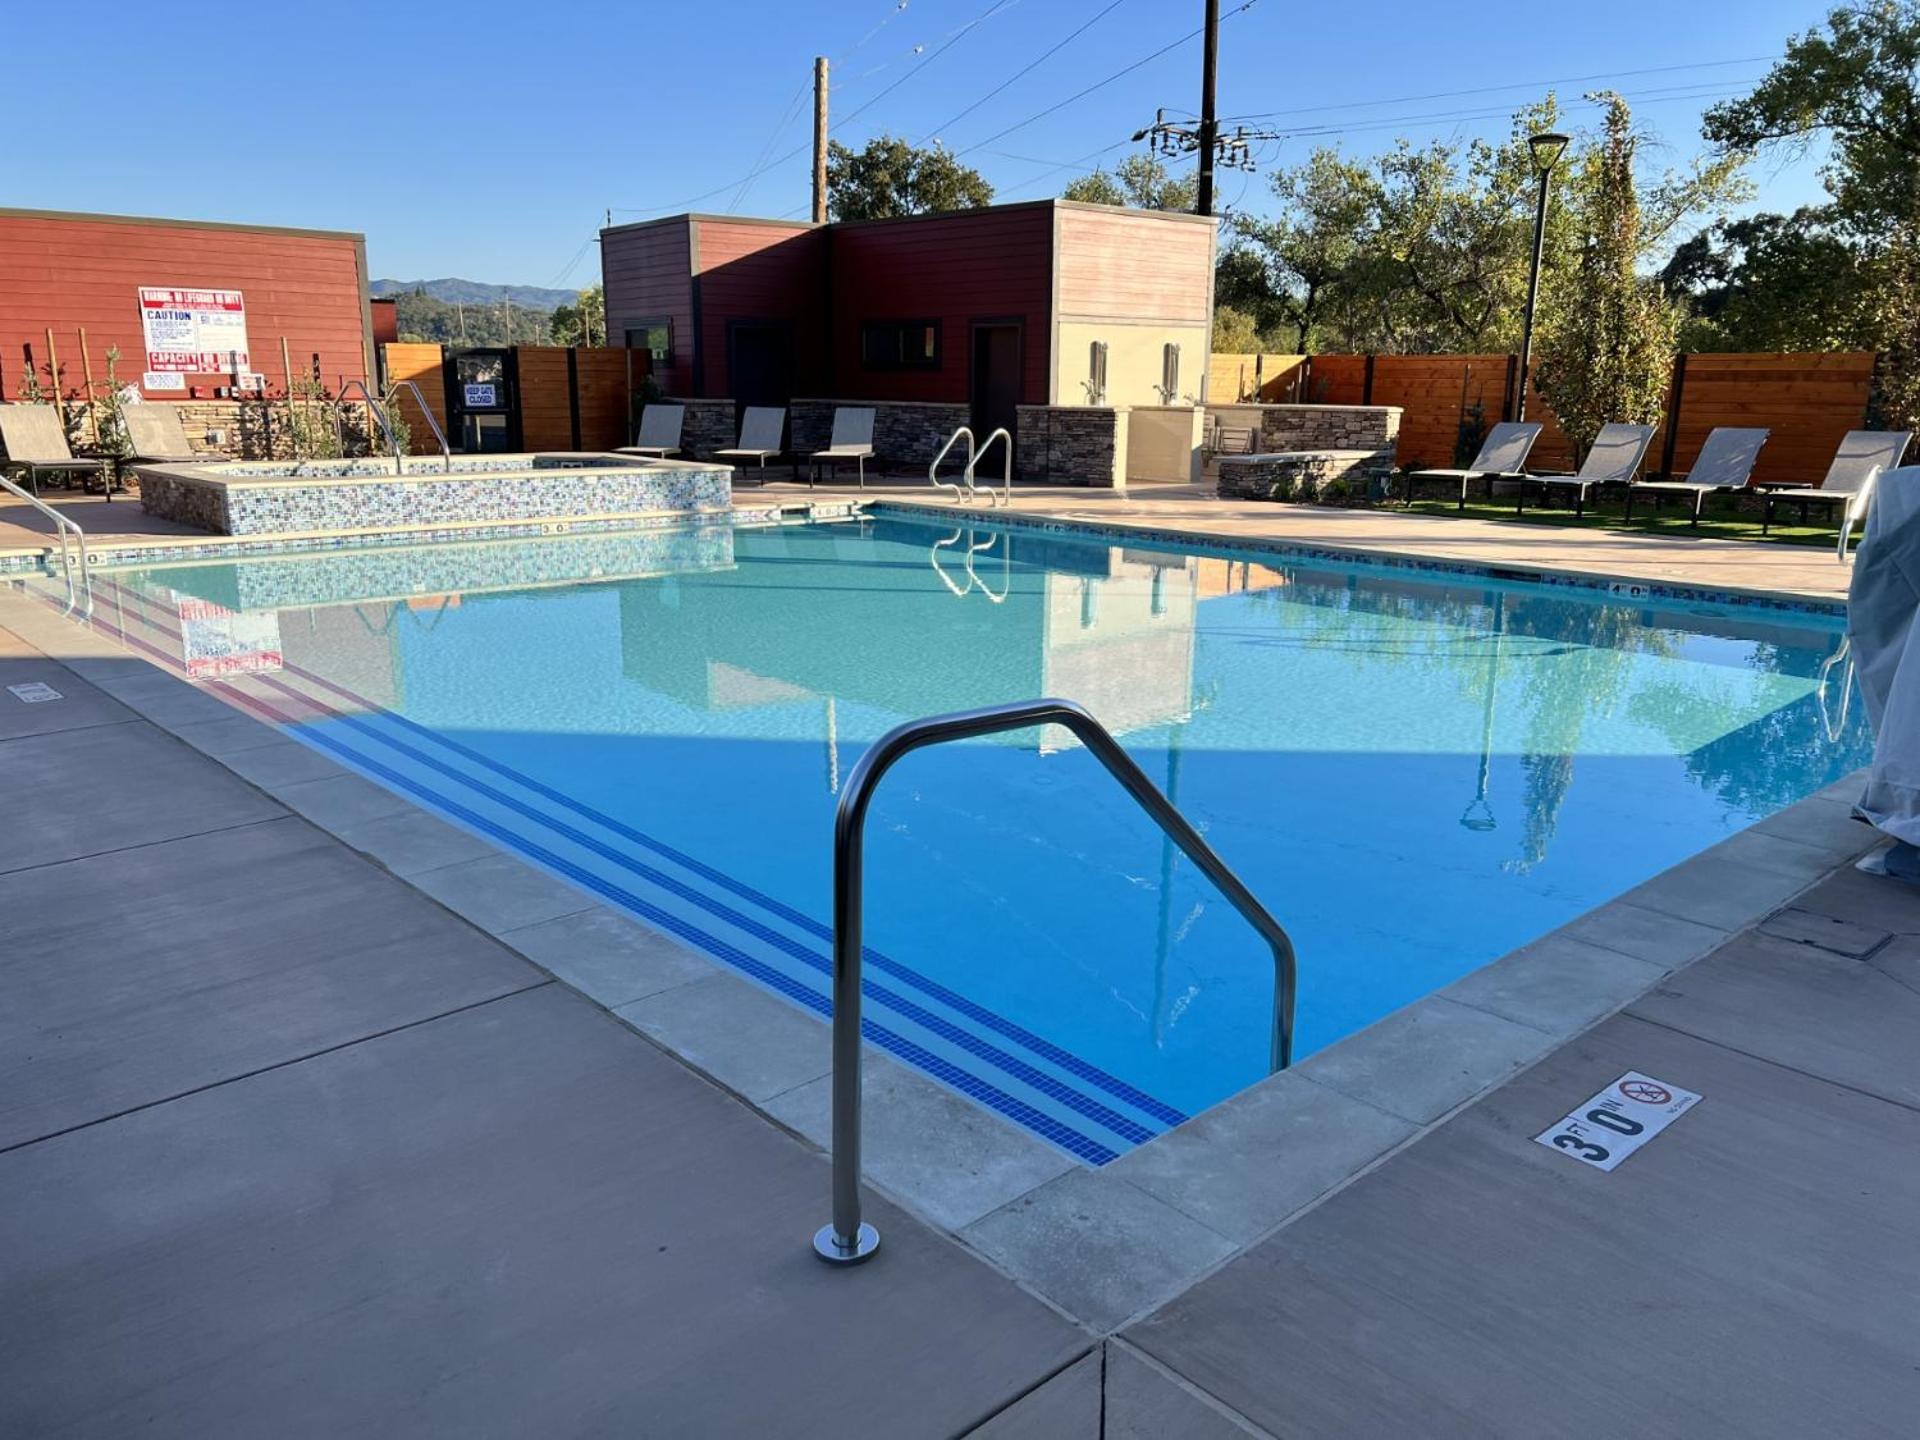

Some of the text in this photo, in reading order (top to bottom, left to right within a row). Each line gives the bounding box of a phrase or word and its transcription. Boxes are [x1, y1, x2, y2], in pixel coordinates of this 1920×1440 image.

[147, 310, 192, 320] CAUTION
[152, 352, 197, 363] CAPACITY
[1553, 1099, 1644, 1162] 3 FT 0 IN
